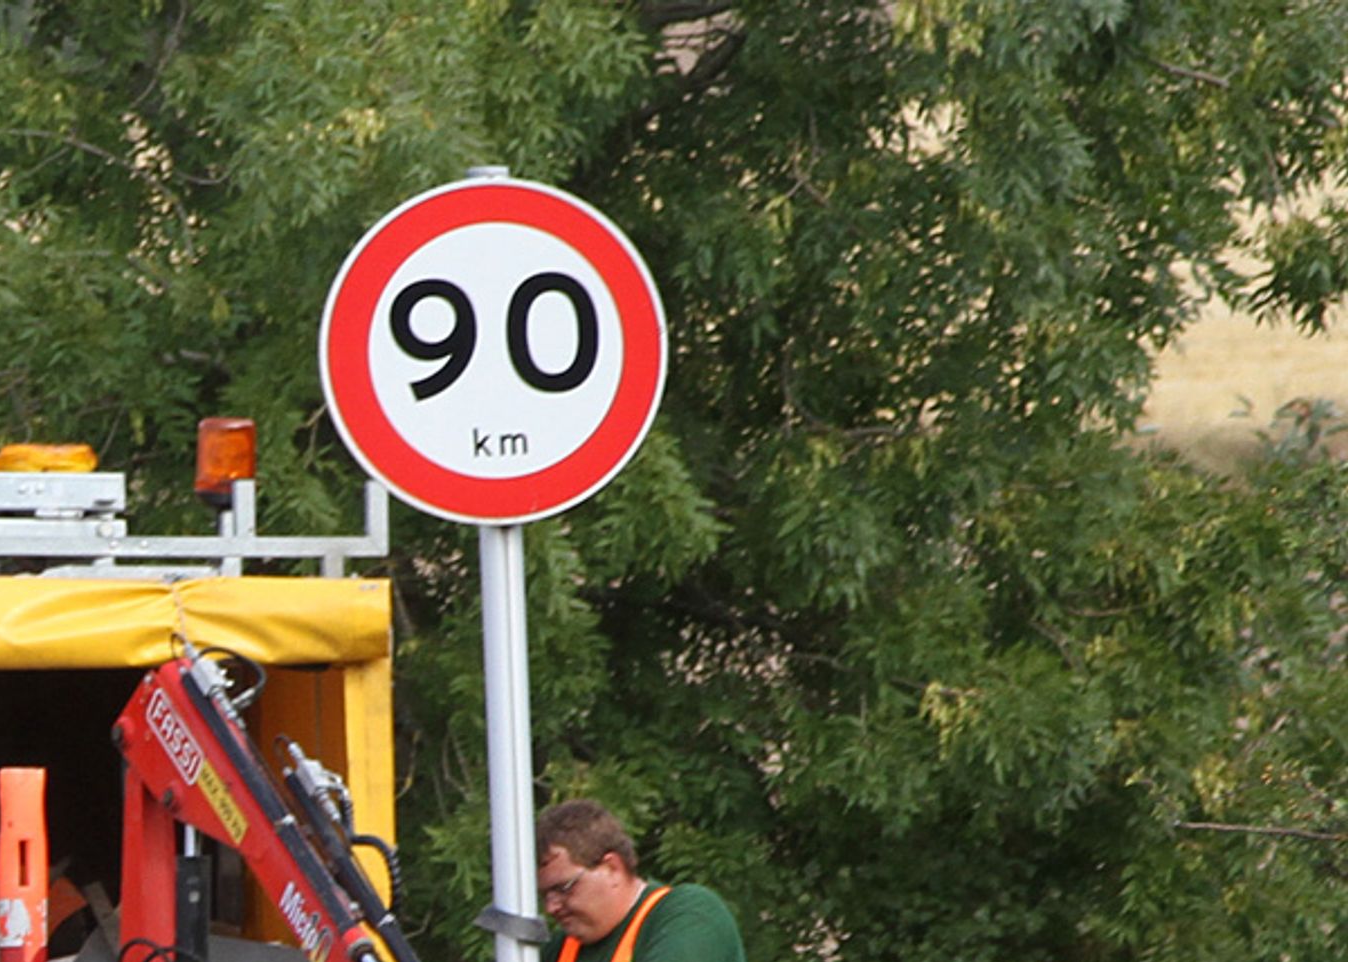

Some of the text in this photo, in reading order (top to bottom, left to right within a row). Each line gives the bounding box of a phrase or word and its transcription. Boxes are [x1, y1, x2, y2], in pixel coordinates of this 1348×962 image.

[389, 271, 599, 401] 90
[473, 428, 528, 457] km
[151, 700, 199, 775] FASSI
